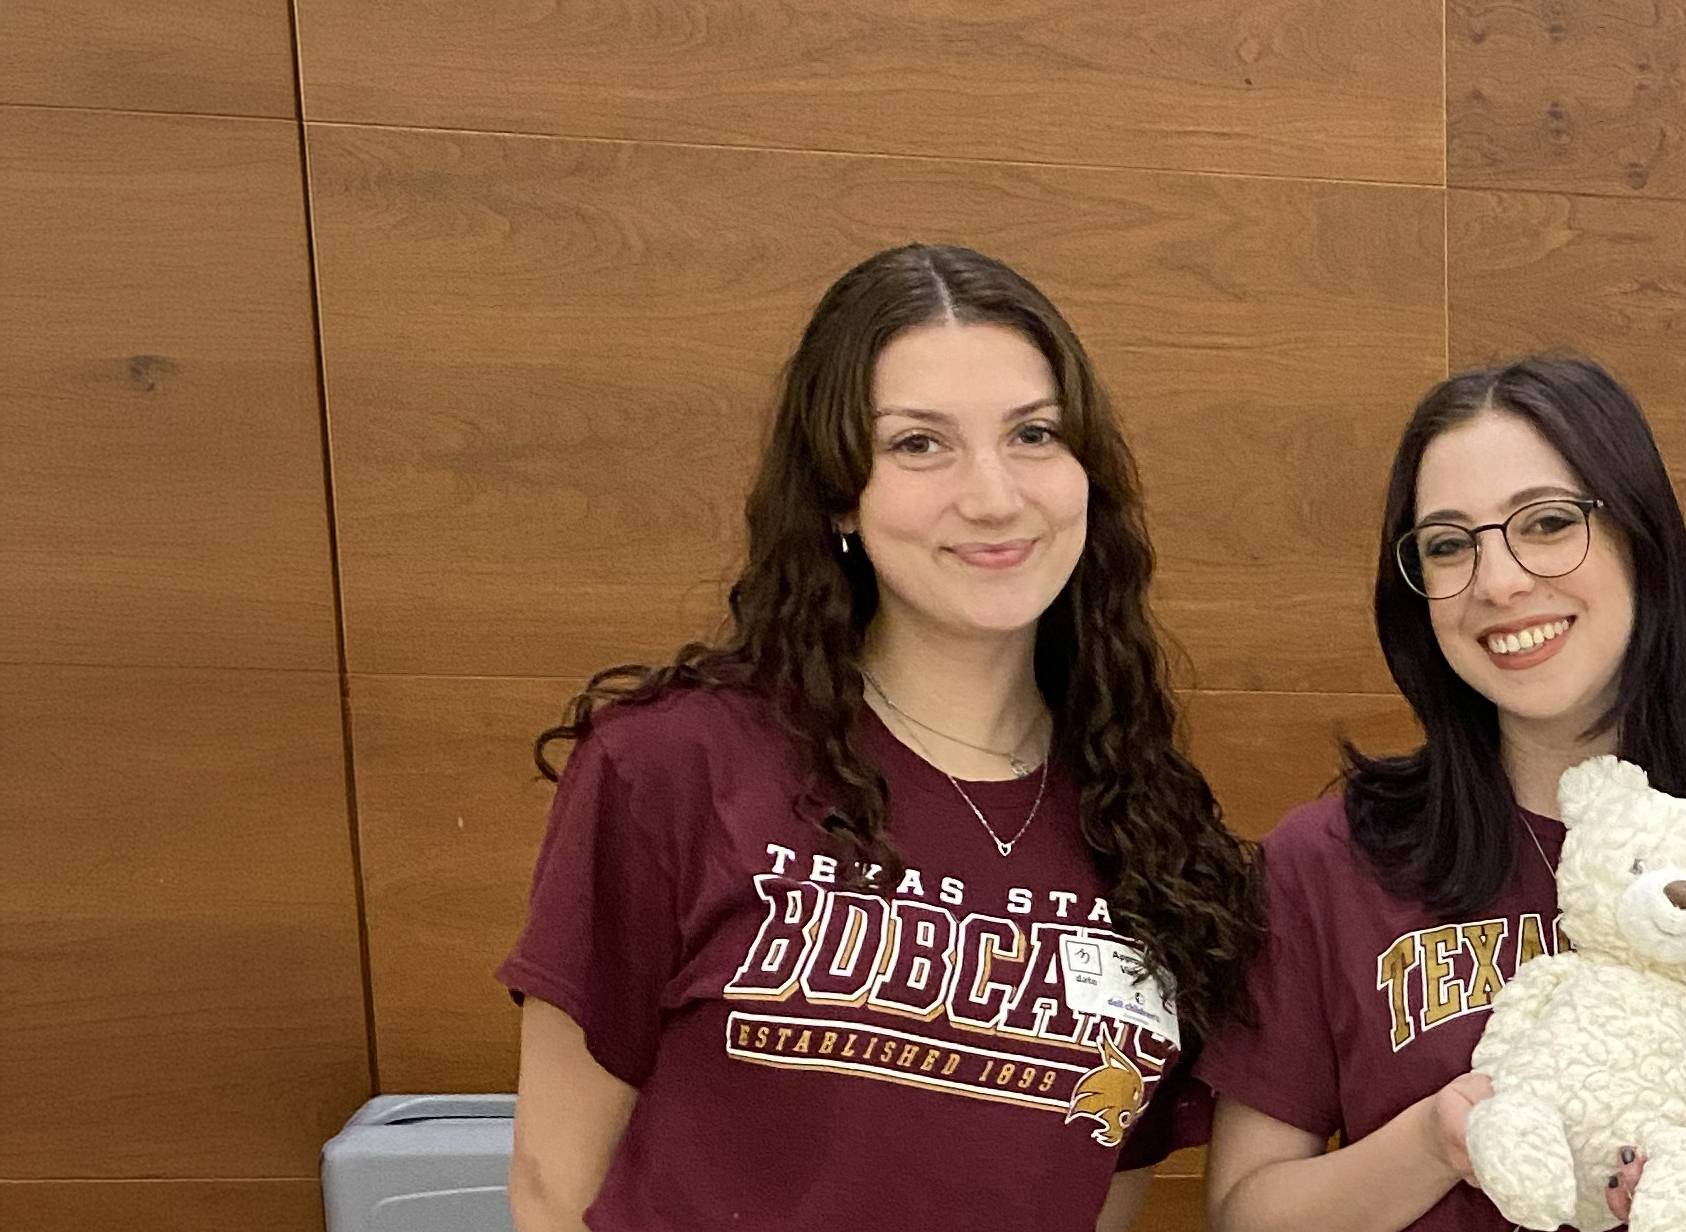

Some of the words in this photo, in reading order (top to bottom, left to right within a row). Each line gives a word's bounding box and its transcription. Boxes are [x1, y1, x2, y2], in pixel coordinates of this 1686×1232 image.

[1007, 888, 1113, 924] STA
[1377, 914, 1572, 1053] TEXA
[737, 1024, 961, 1075] ESTABLISHED
[978, 1060, 1057, 1092] 1899
